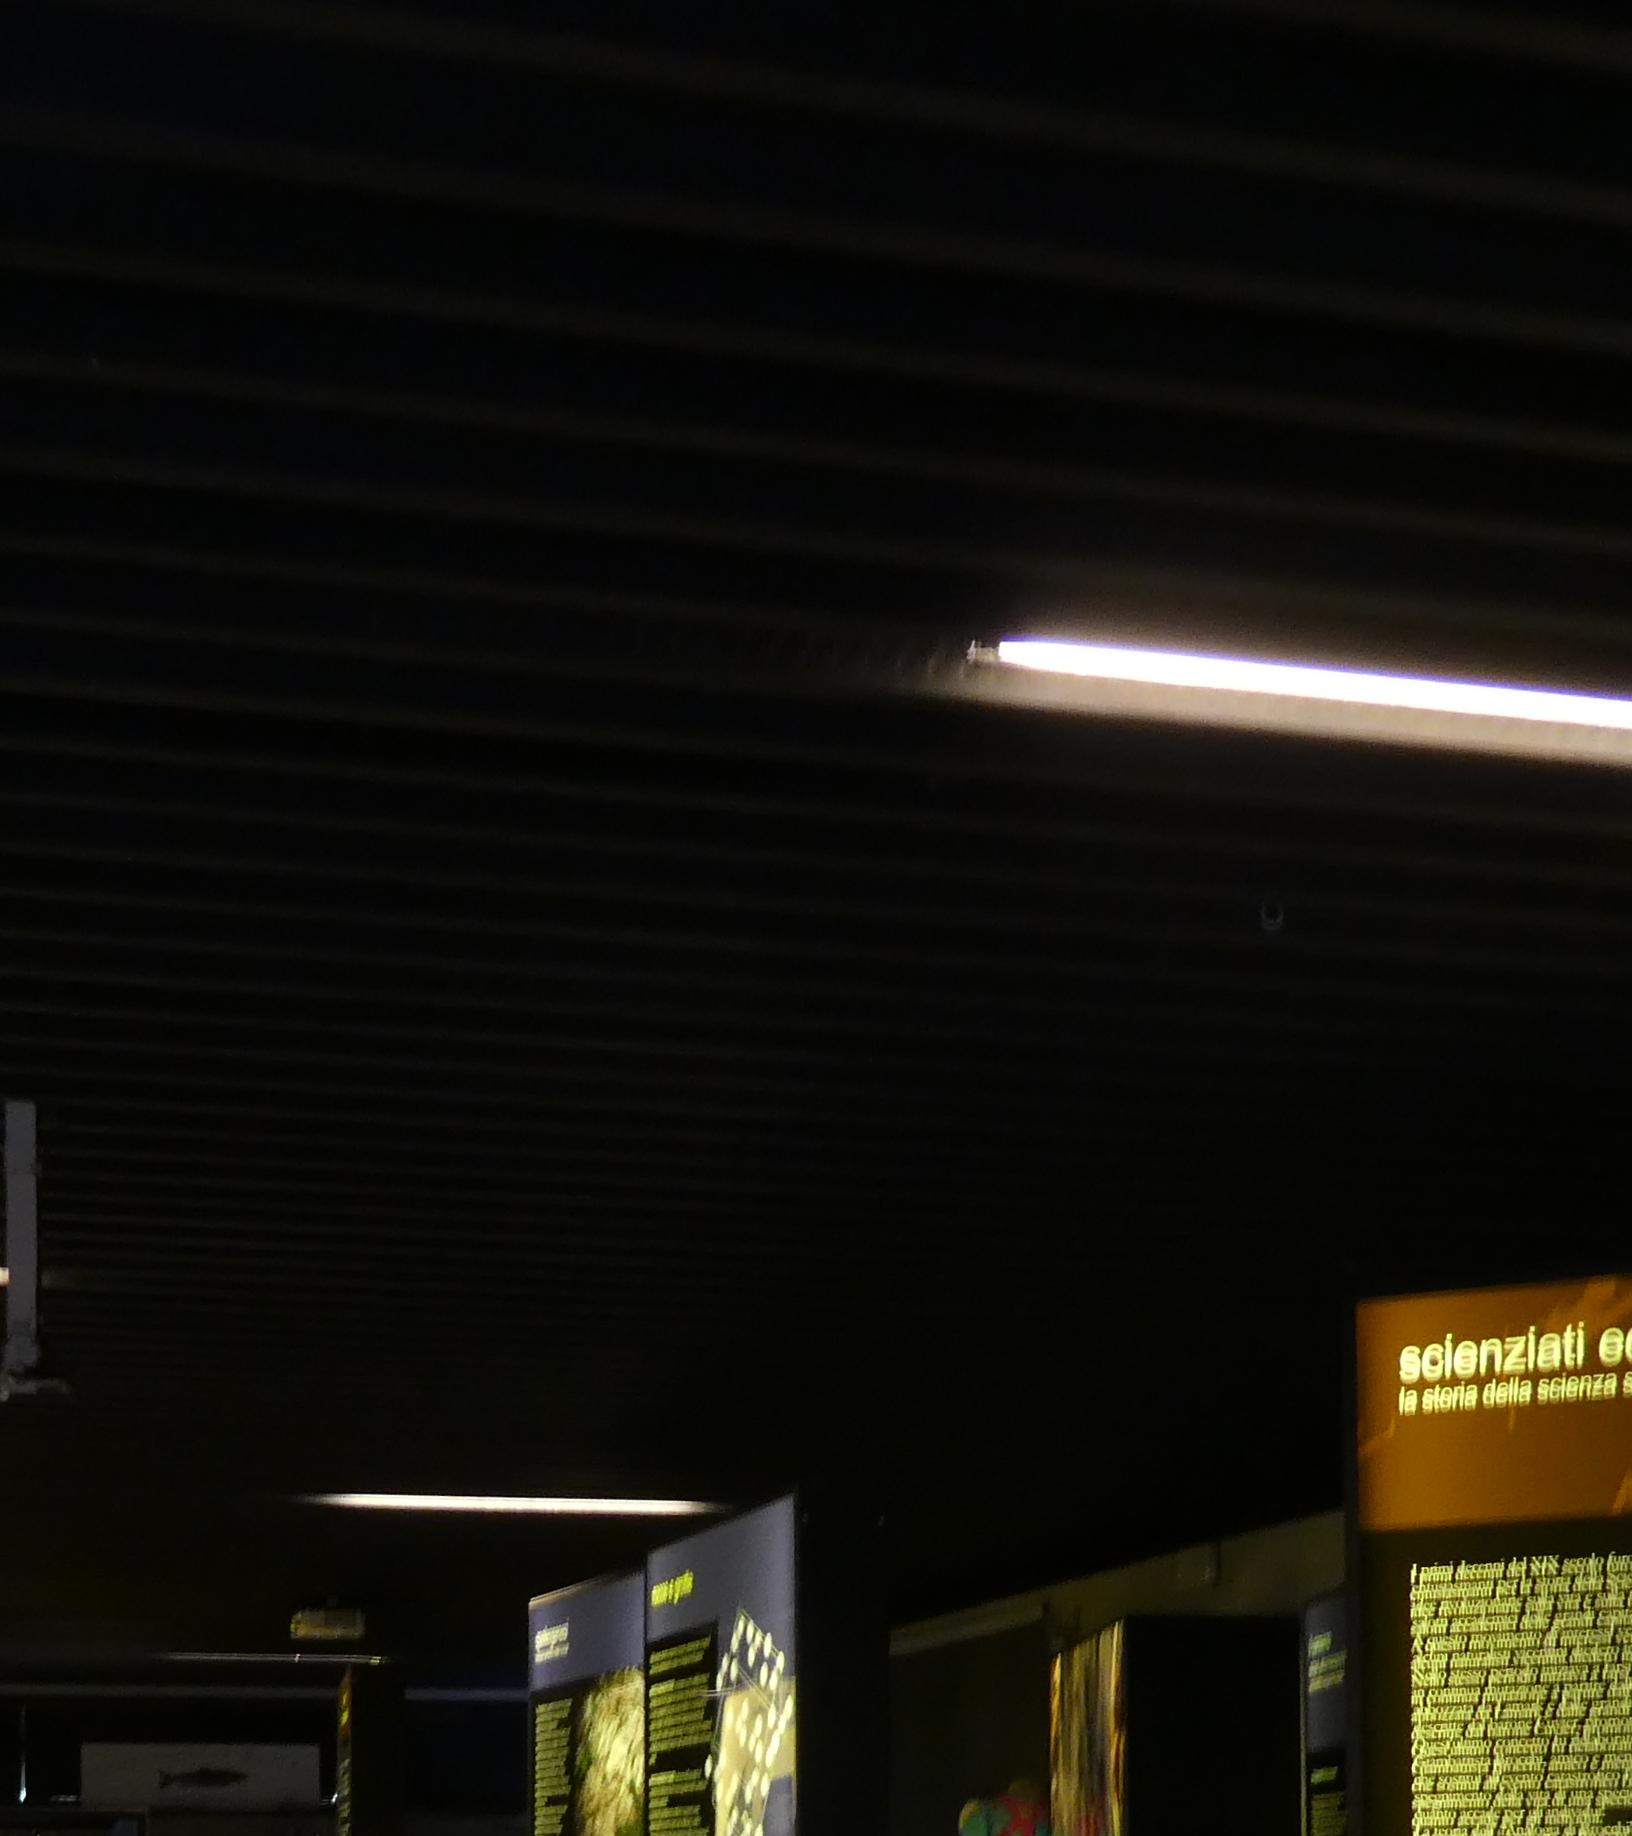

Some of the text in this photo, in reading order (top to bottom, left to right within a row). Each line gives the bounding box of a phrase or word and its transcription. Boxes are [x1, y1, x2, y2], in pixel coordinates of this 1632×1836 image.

[1399, 1321, 1585, 1384] scienziati
[1421, 1379, 1477, 1413] storia
[1483, 1376, 1532, 1408] della
[1538, 1372, 1617, 1405] scienza
